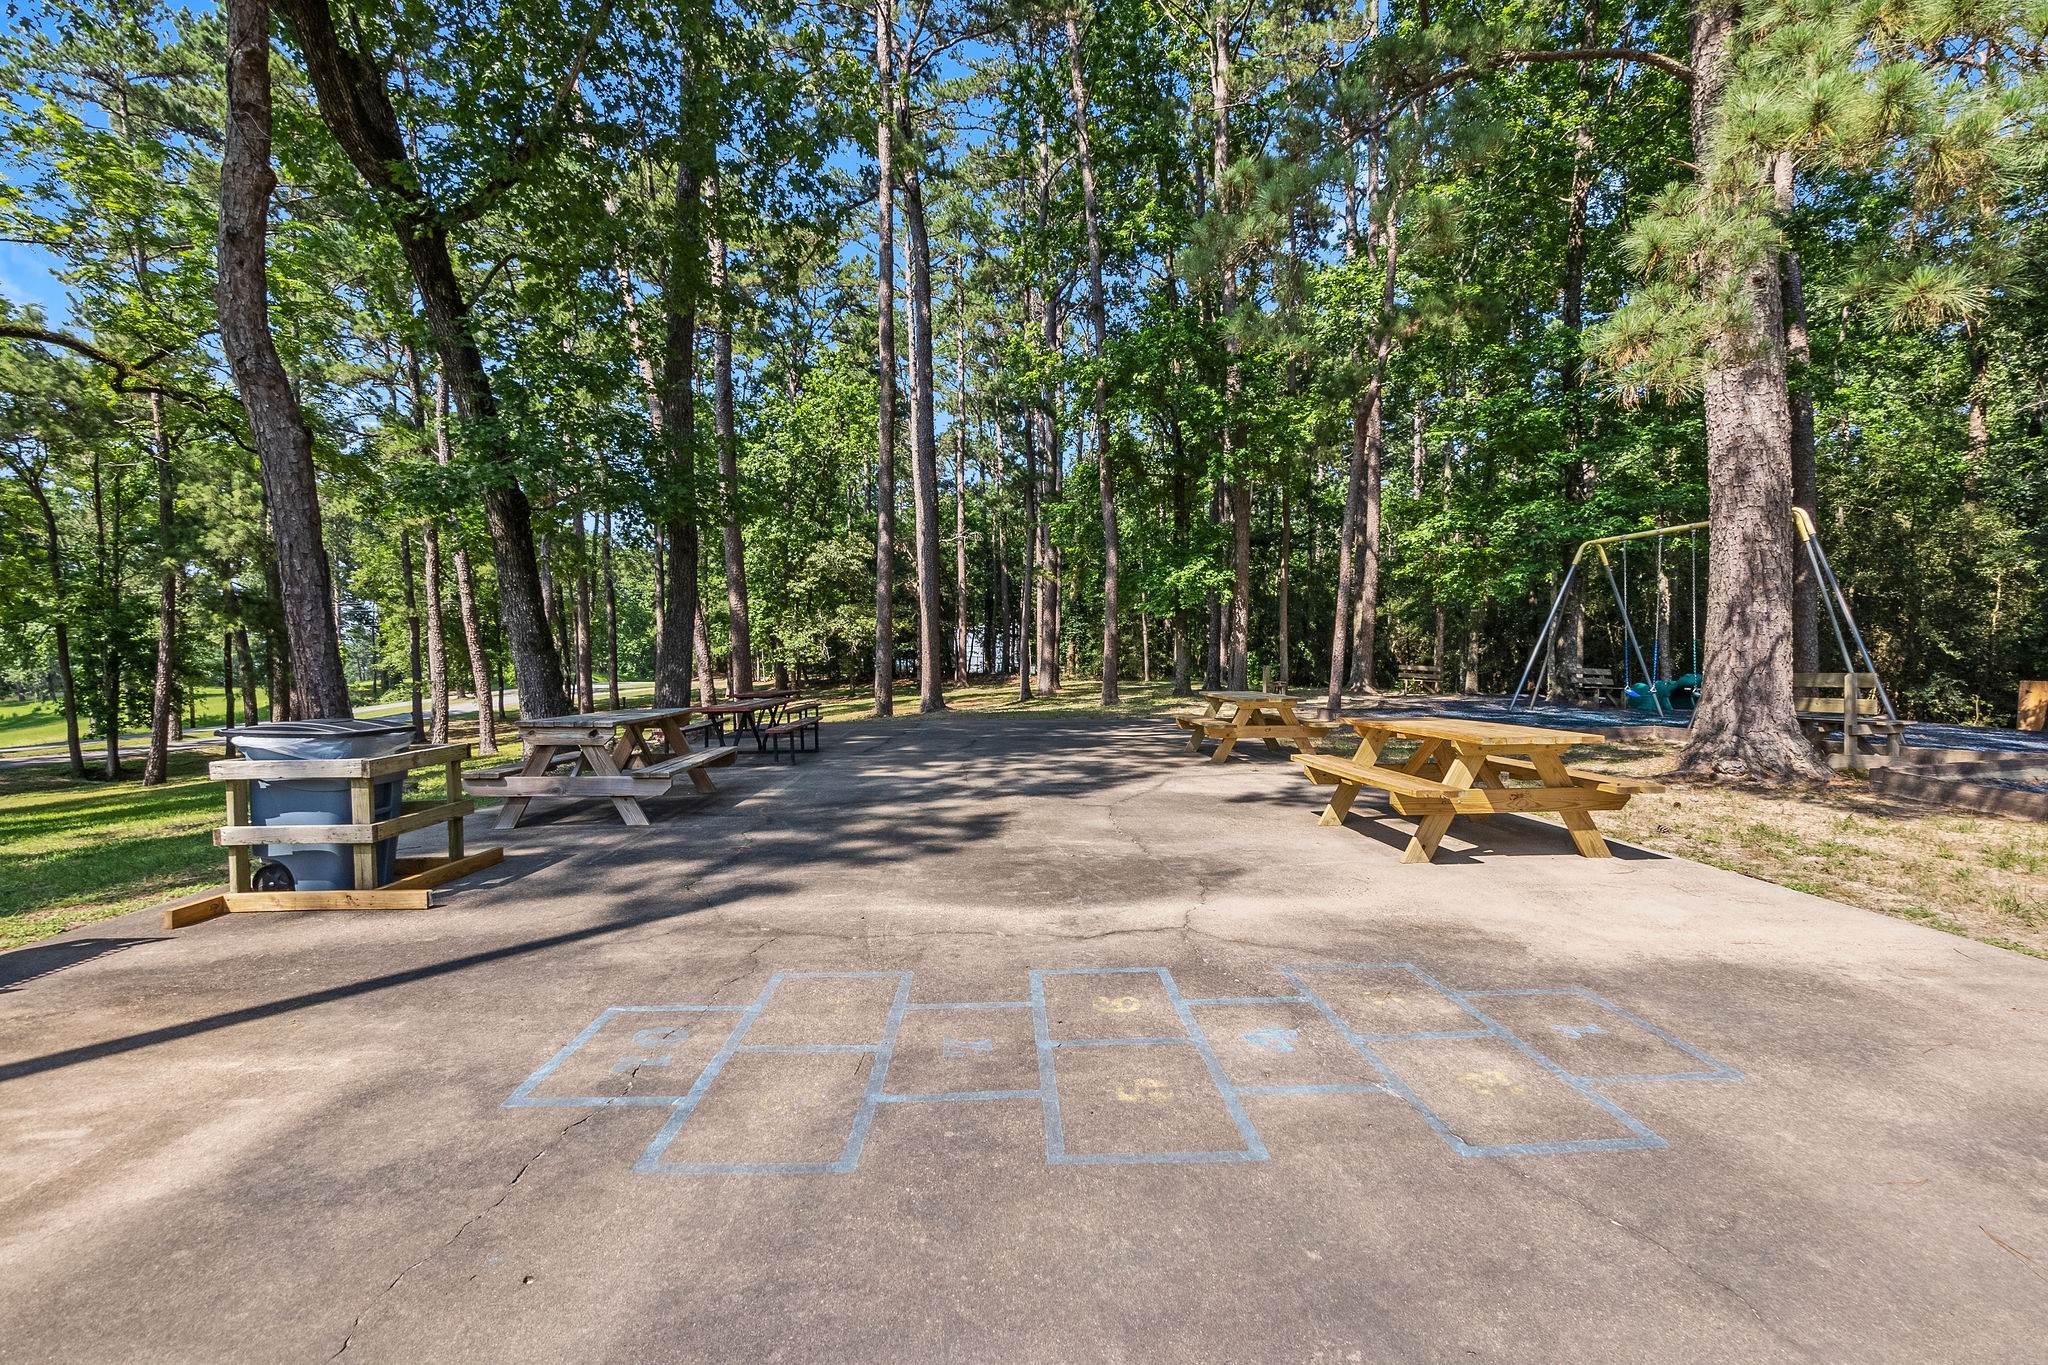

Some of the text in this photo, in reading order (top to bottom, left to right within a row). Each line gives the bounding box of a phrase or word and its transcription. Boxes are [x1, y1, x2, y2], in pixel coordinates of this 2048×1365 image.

[1091, 995, 1141, 1013] 6
[609, 1026, 690, 1073] 10
[943, 1036, 993, 1059] 7
[1241, 1024, 1299, 1054] 4
